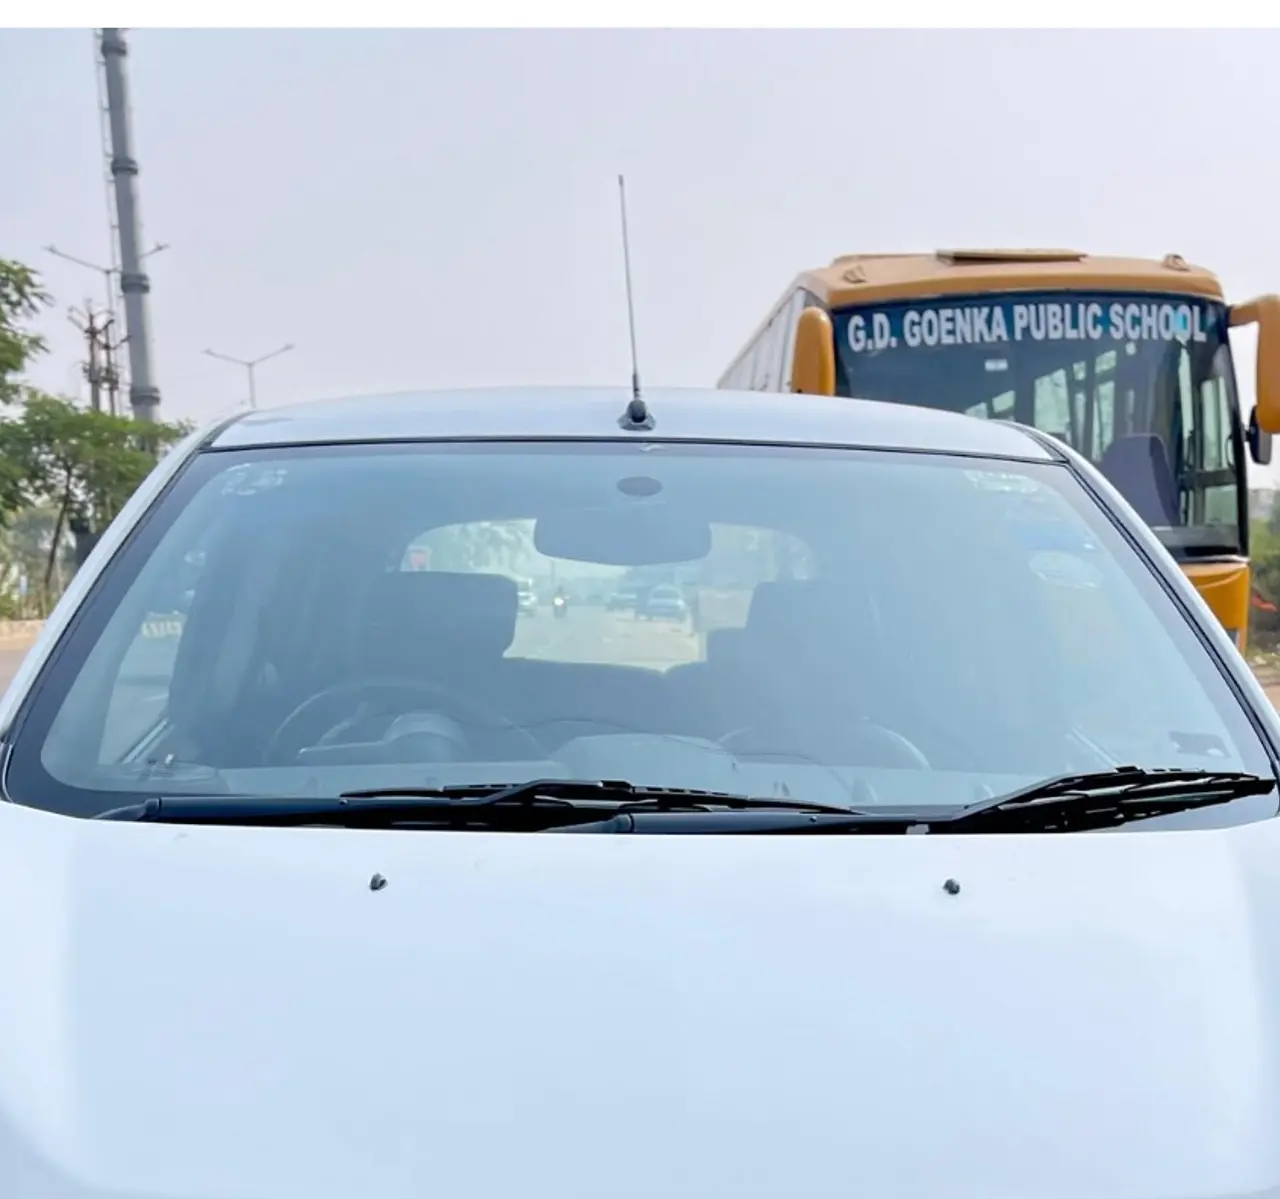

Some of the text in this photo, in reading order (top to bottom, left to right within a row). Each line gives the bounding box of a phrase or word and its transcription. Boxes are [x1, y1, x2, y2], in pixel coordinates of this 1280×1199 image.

[847, 303, 1207, 352] G.D. GOENKA PUBLIC SCHOOL
